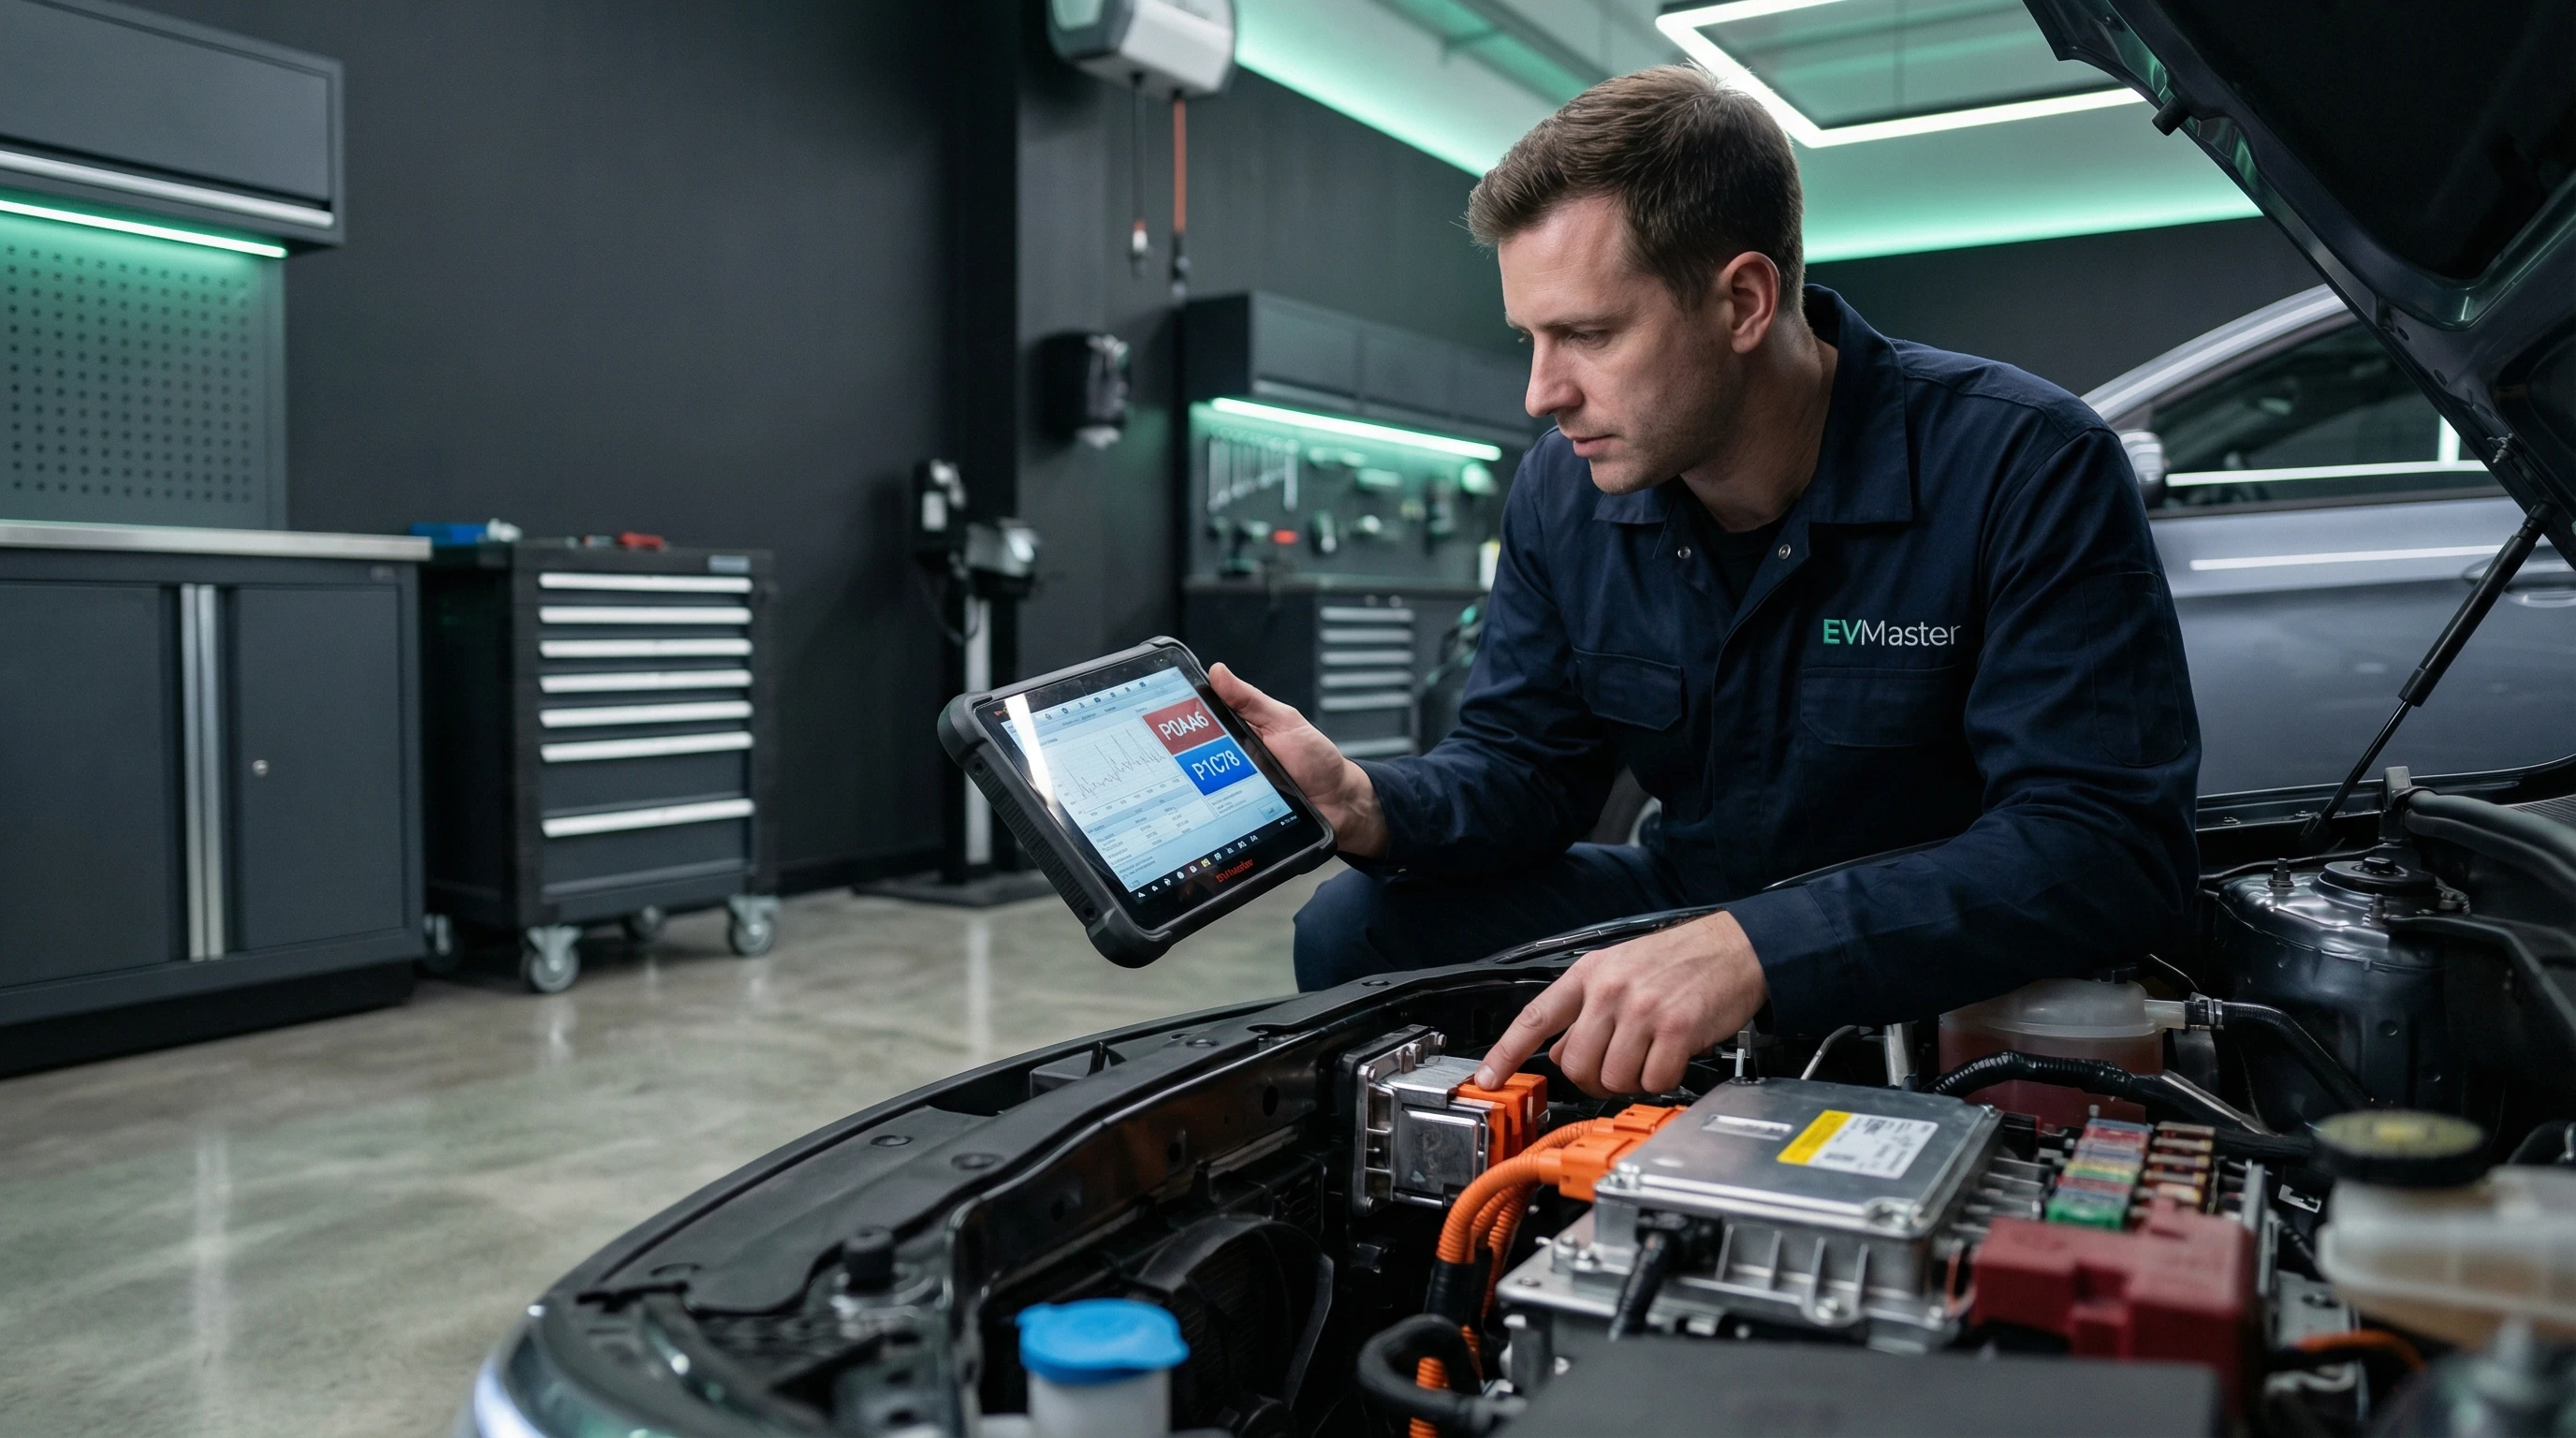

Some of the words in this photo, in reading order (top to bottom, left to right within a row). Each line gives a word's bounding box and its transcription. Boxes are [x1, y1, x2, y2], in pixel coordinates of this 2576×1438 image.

[1823, 619, 1961, 646] EVMaster
[1158, 712, 1209, 741] P0AA6
[1192, 750, 1240, 781] P1C78
